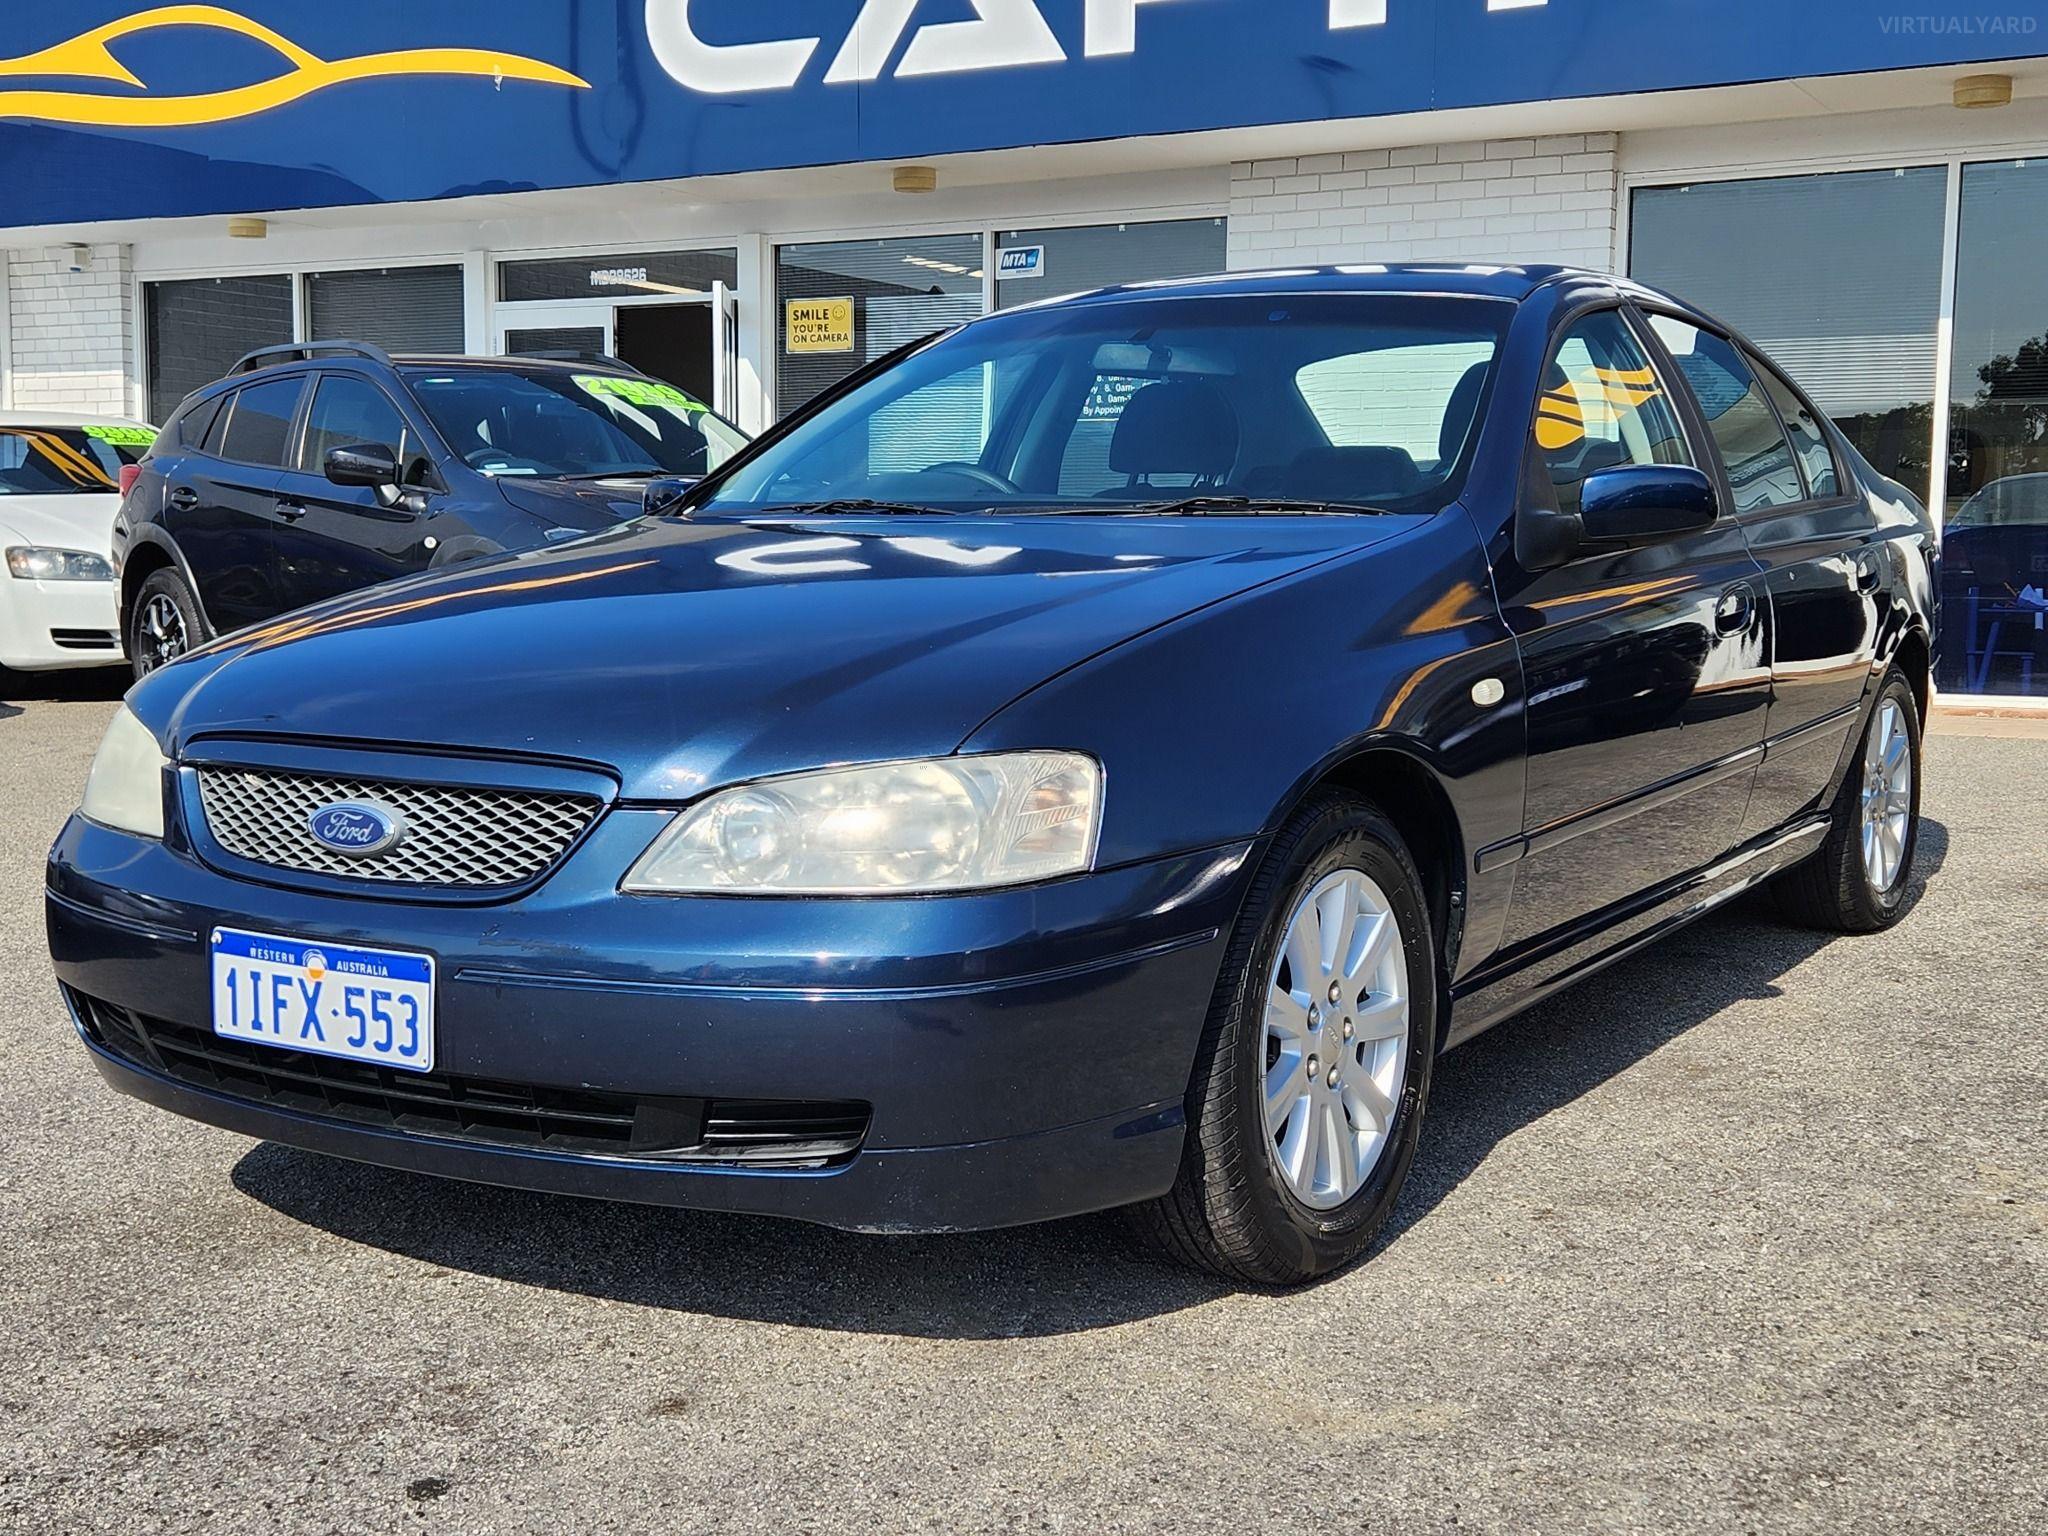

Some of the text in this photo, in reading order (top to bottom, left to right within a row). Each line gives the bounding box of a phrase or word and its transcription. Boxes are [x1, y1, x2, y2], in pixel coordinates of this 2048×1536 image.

[1002, 252, 1027, 268] MTA
[793, 308, 830, 321] SMILE
[793, 323, 830, 334] YOU'RE
[793, 332, 849, 343] ON CAMERA
[324, 811, 375, 843] Ford
[250, 947, 389, 977] WESTERN AUSTRALIA
